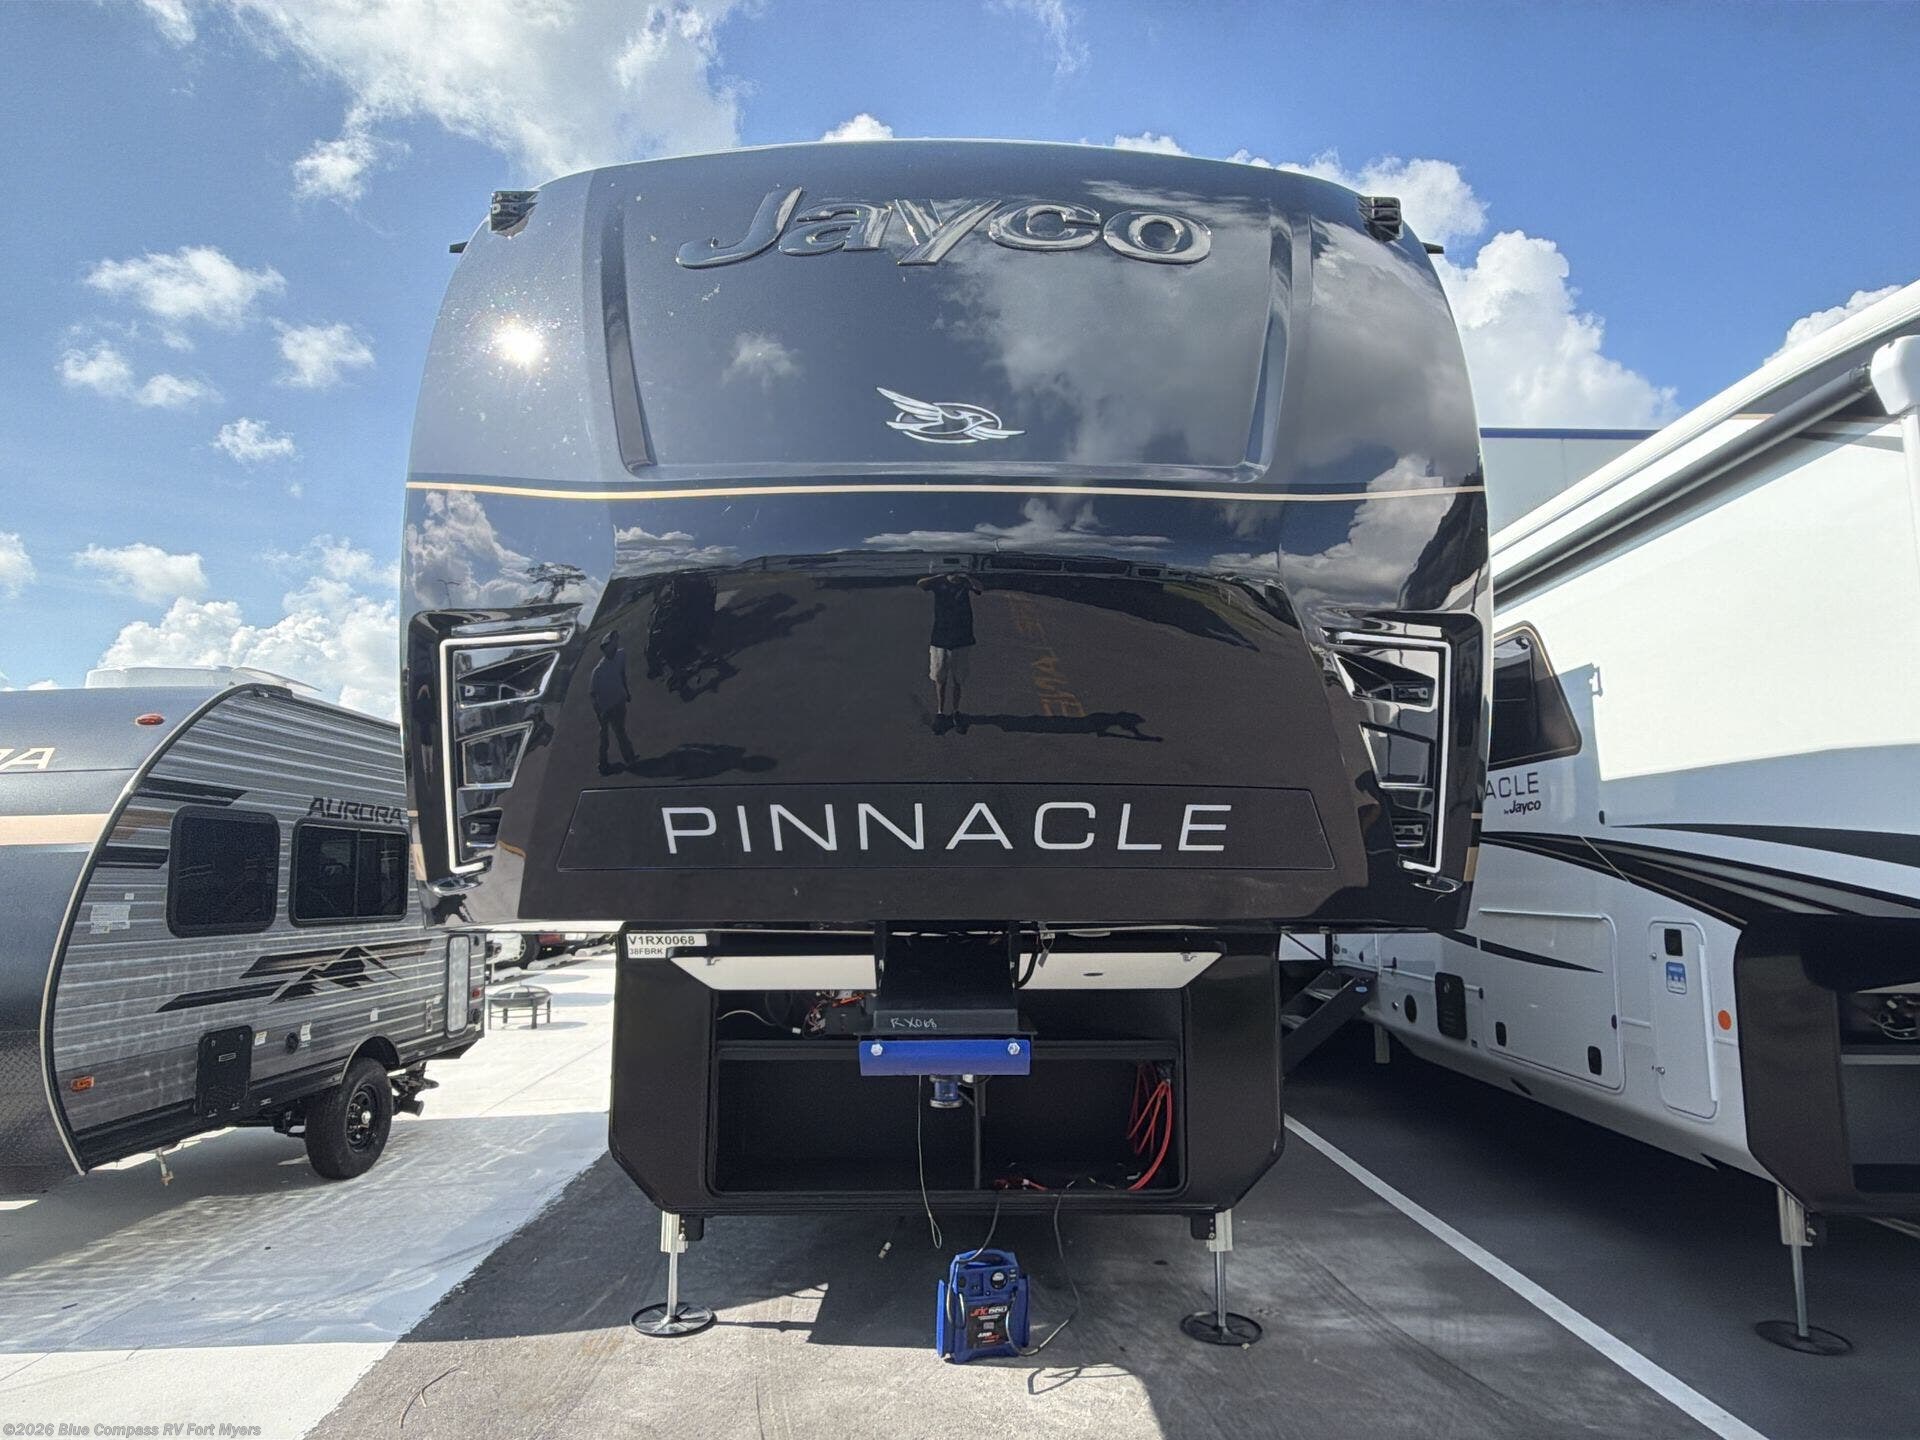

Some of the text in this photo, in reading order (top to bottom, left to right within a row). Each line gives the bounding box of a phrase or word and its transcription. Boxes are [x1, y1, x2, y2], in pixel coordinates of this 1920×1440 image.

[676, 186, 1213, 268] Jayco
[306, 797, 404, 825] AURORA
[1509, 800, 1542, 815] Jayco
[661, 801, 1232, 854] PINNACLE
[628, 935, 696, 946] V1RX0068
[629, 947, 664, 956] 38FBRK
